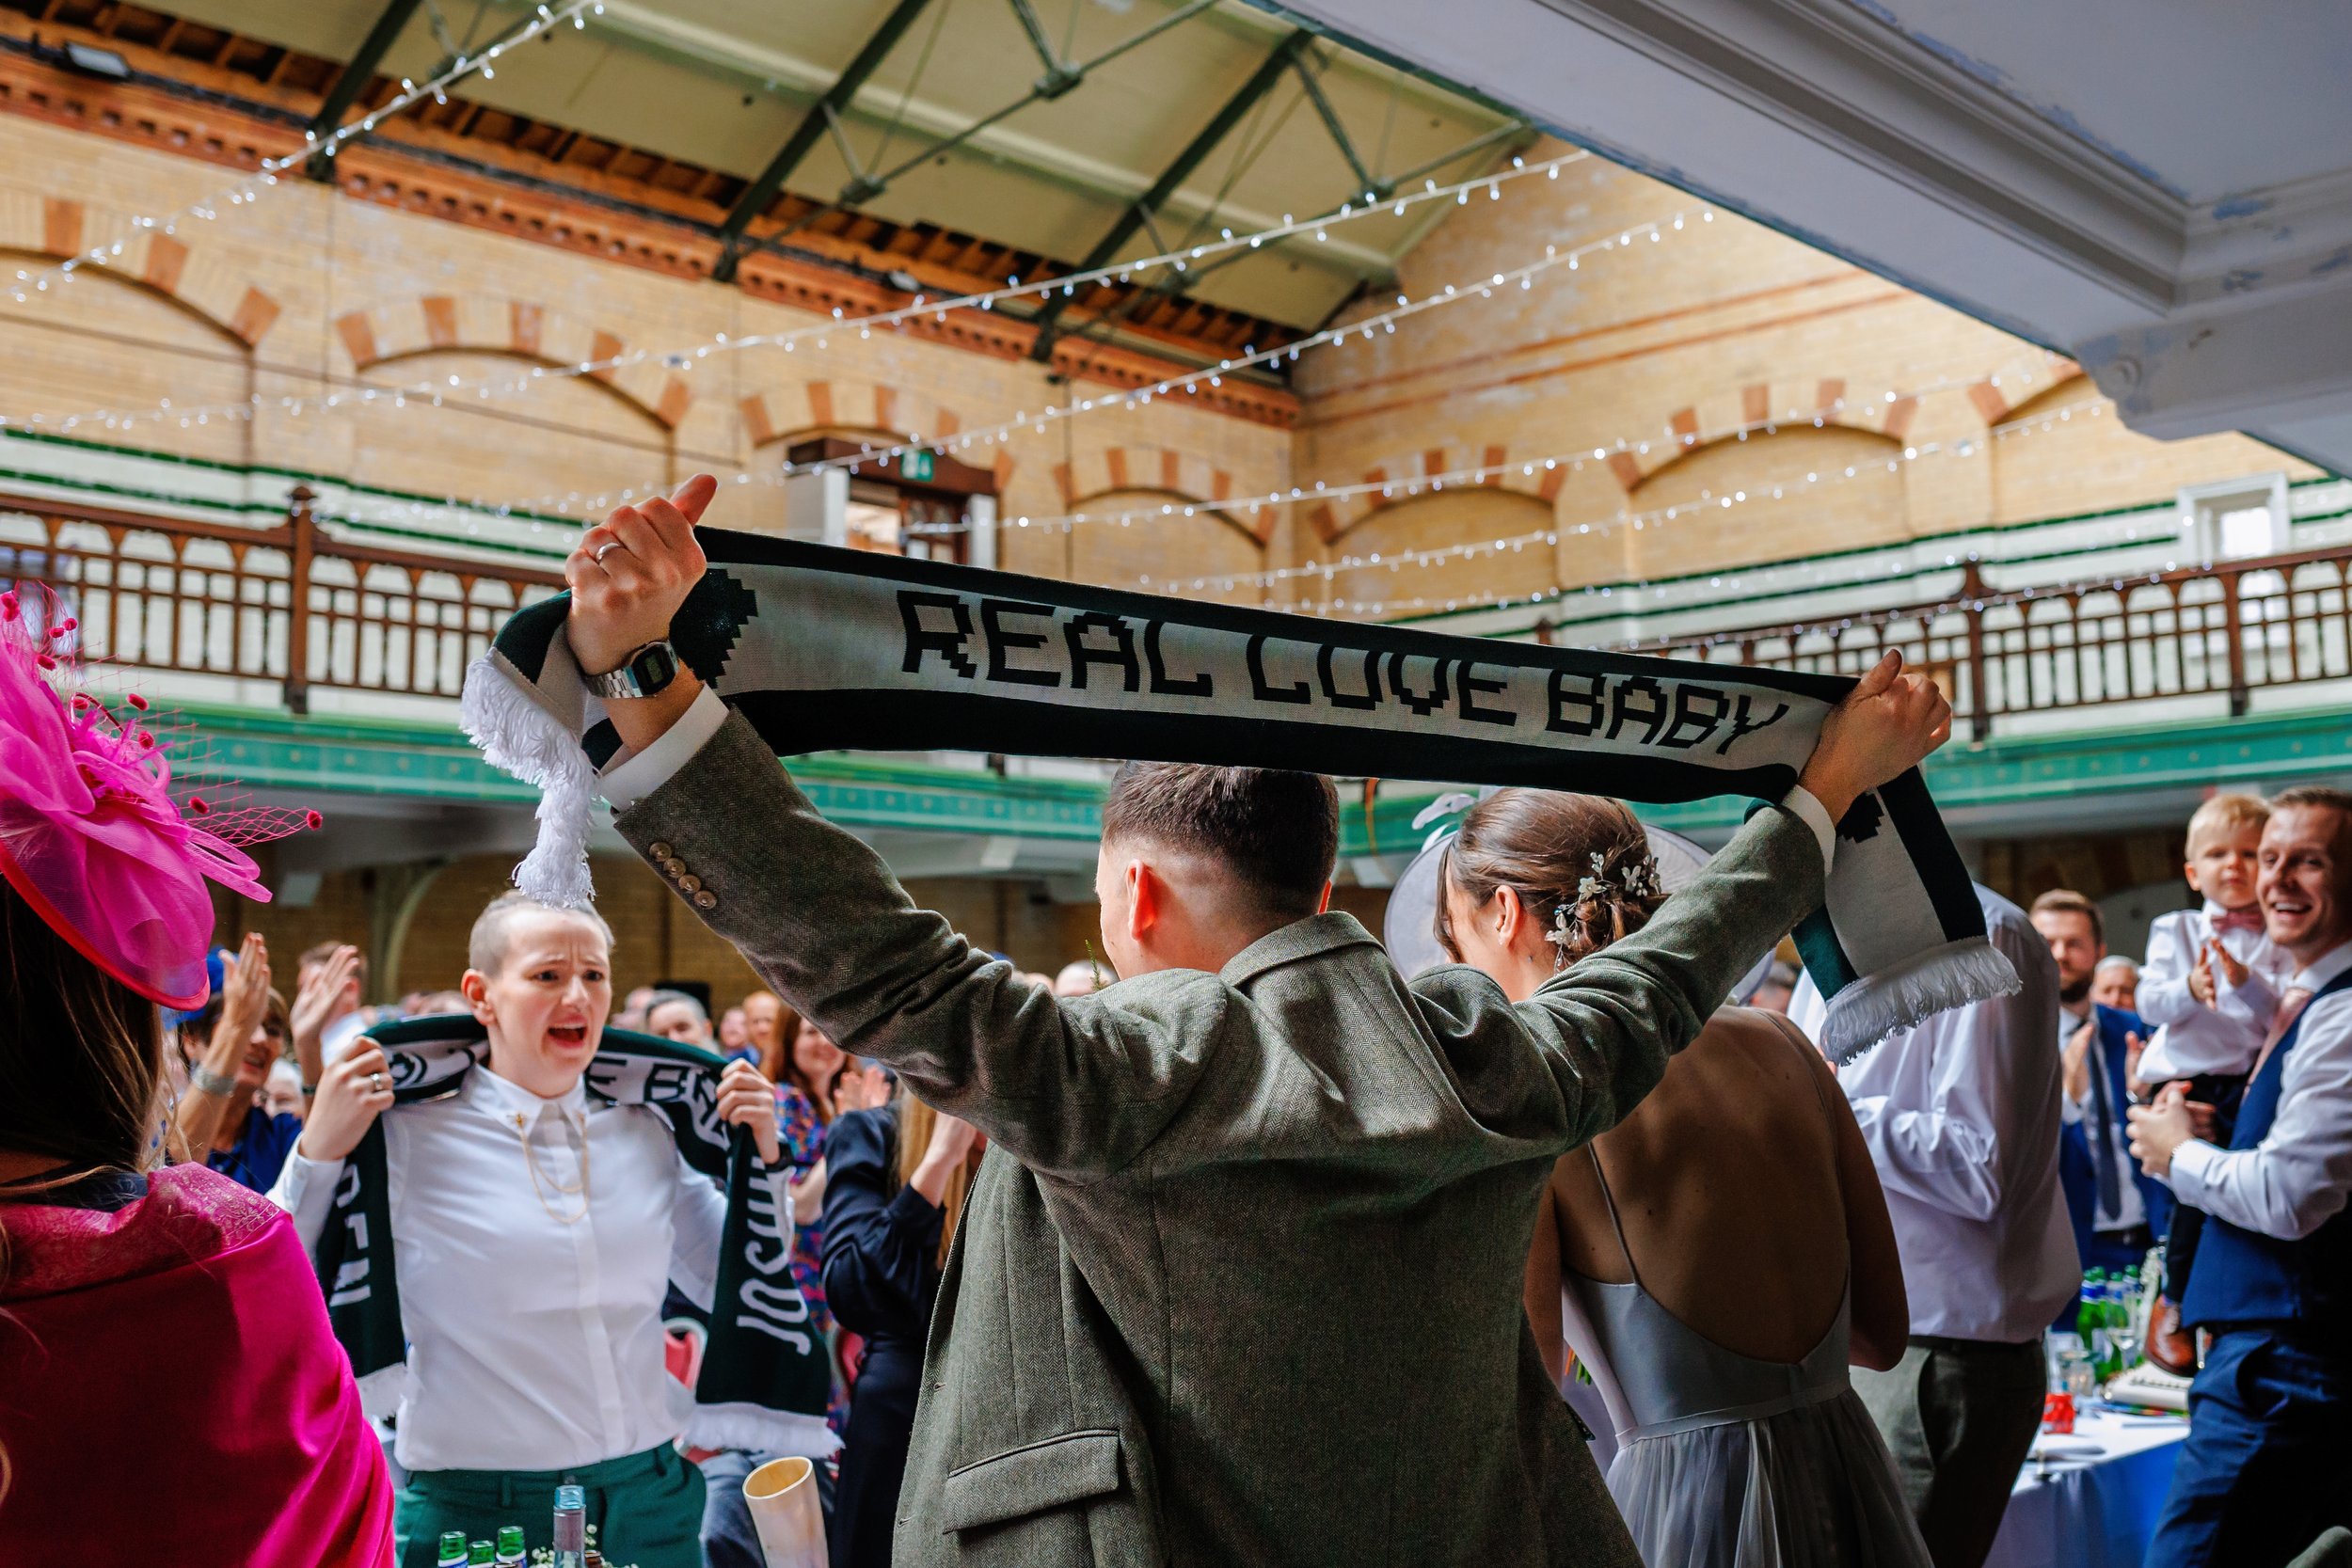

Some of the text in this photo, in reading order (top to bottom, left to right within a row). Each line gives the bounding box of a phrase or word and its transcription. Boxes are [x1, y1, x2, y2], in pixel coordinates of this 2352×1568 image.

[897, 589, 1791, 756] REAL LOVE BABY
